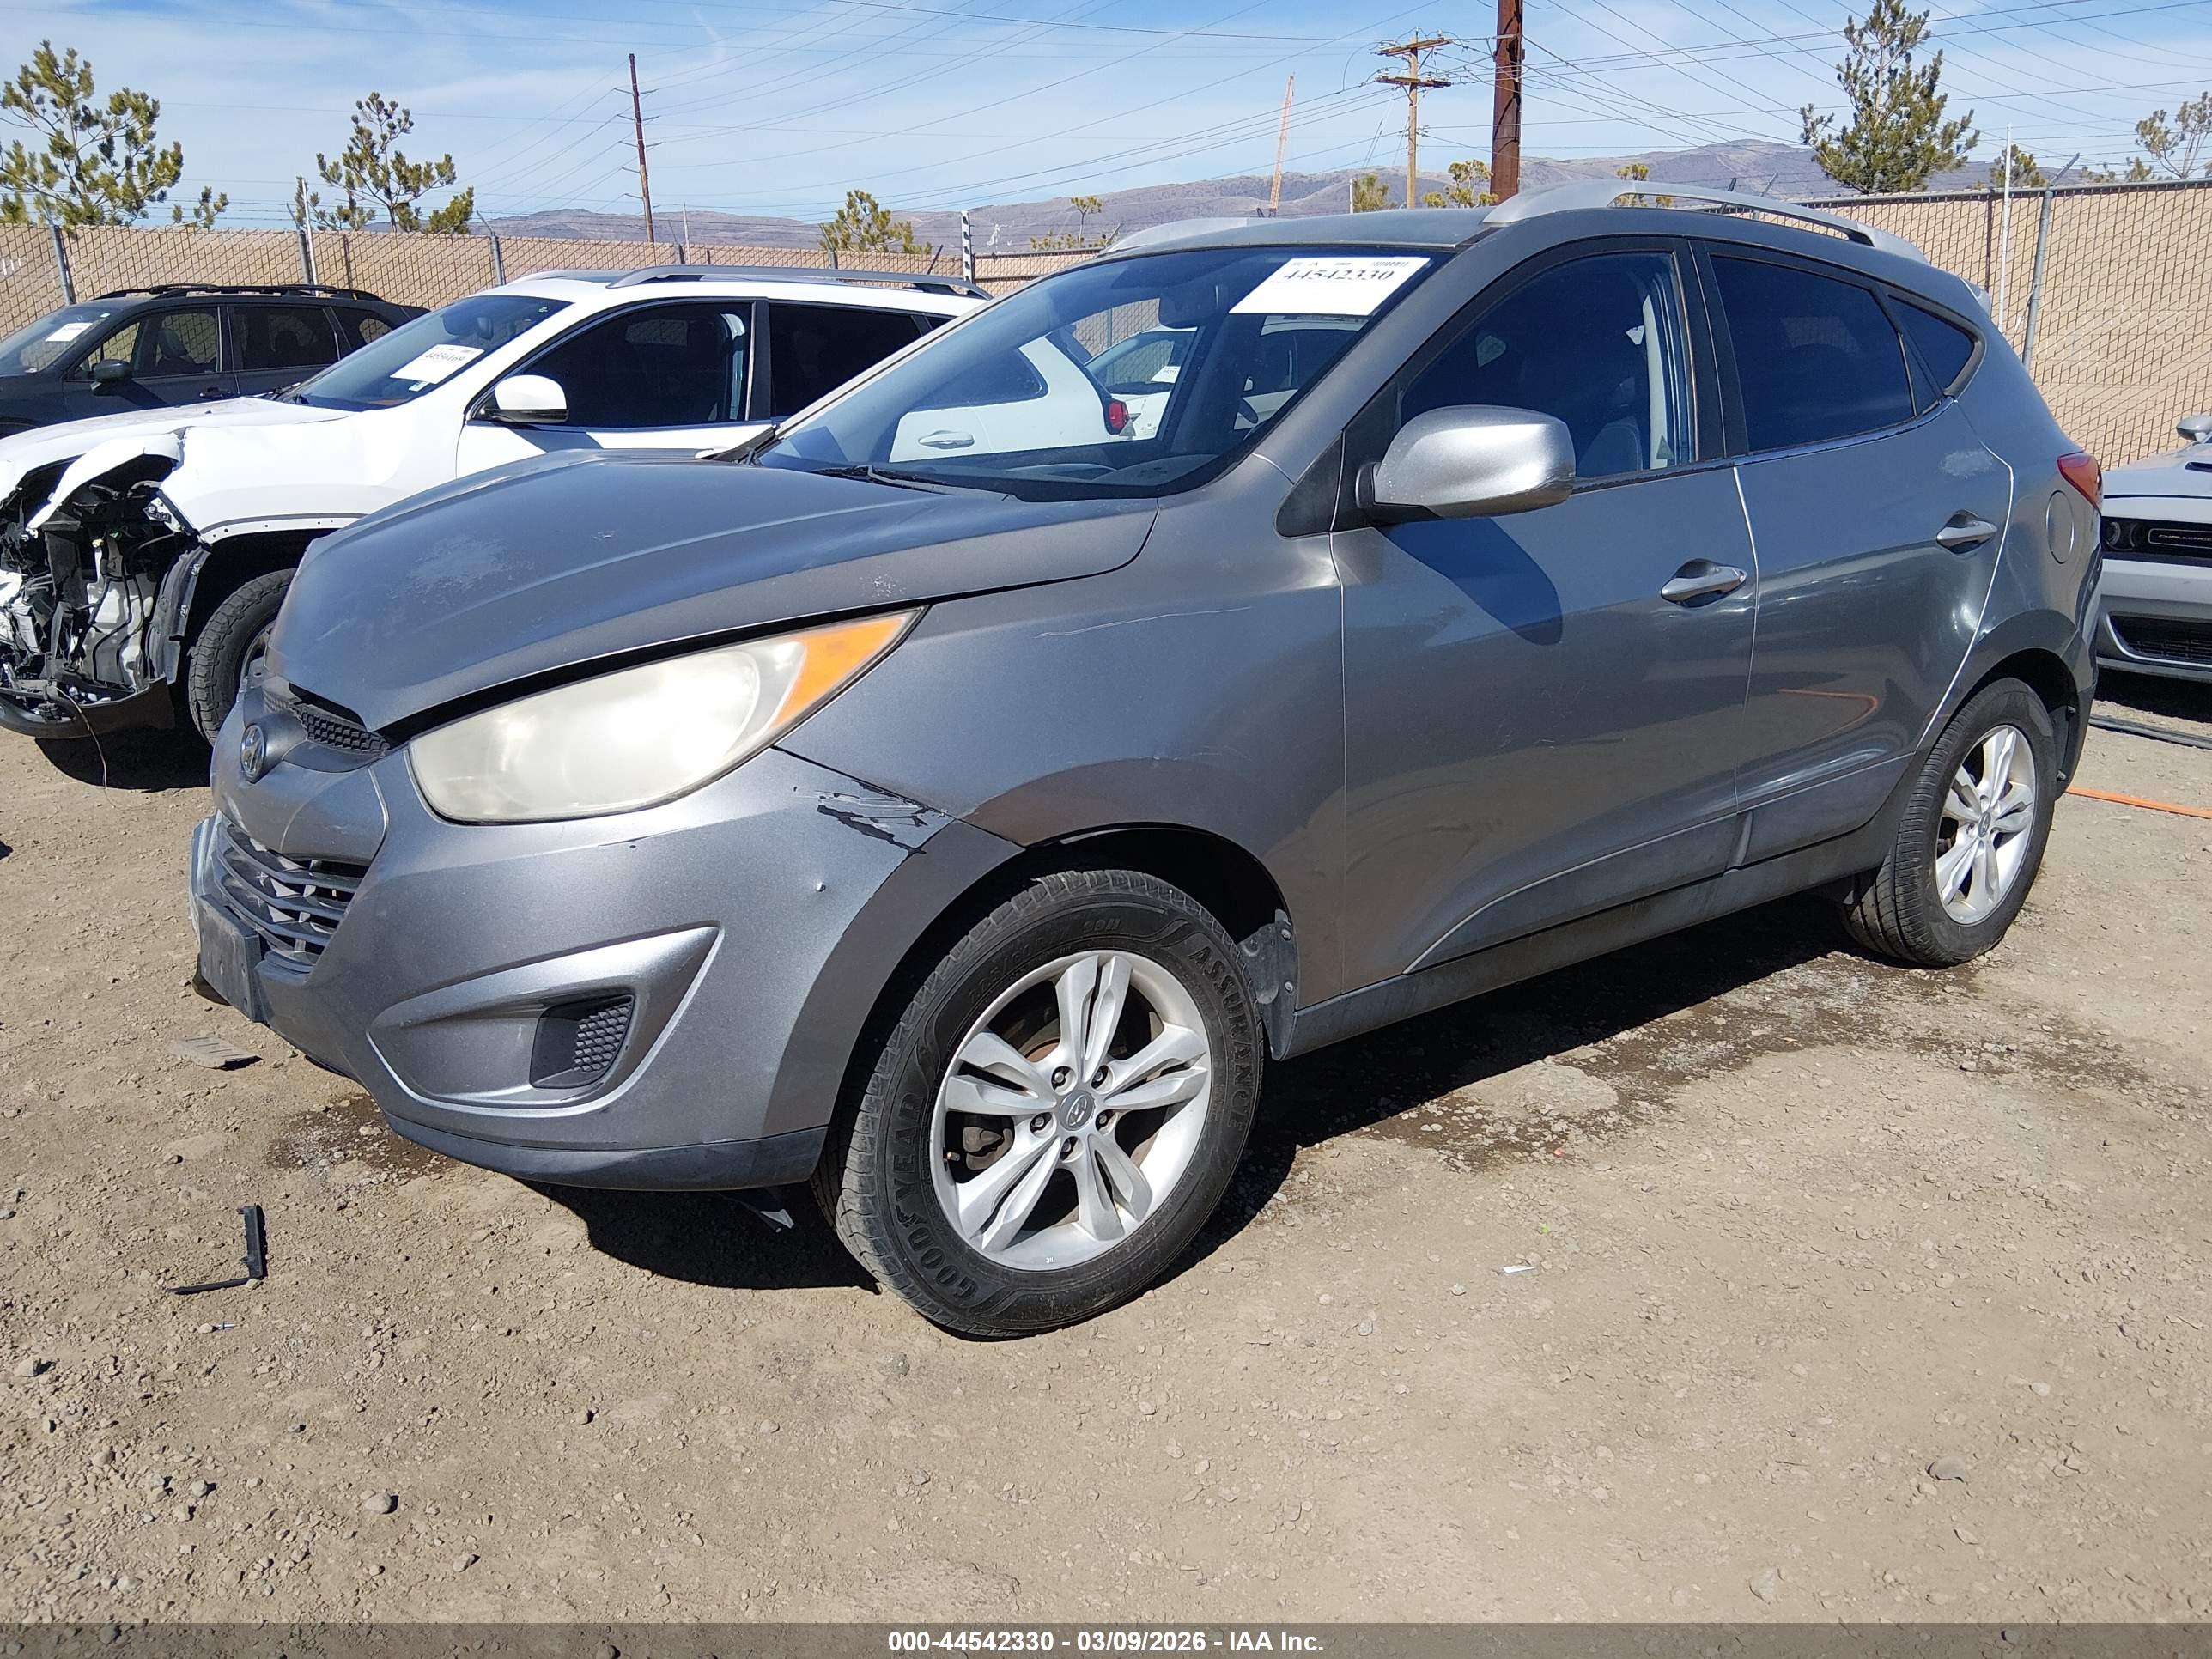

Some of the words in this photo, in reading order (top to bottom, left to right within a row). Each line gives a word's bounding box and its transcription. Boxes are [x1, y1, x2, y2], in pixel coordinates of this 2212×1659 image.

[1283, 269, 1395, 281] 44542330
[1188, 946, 1254, 1131] ASSURANCE
[894, 1092, 980, 1300] GOODYEAR
